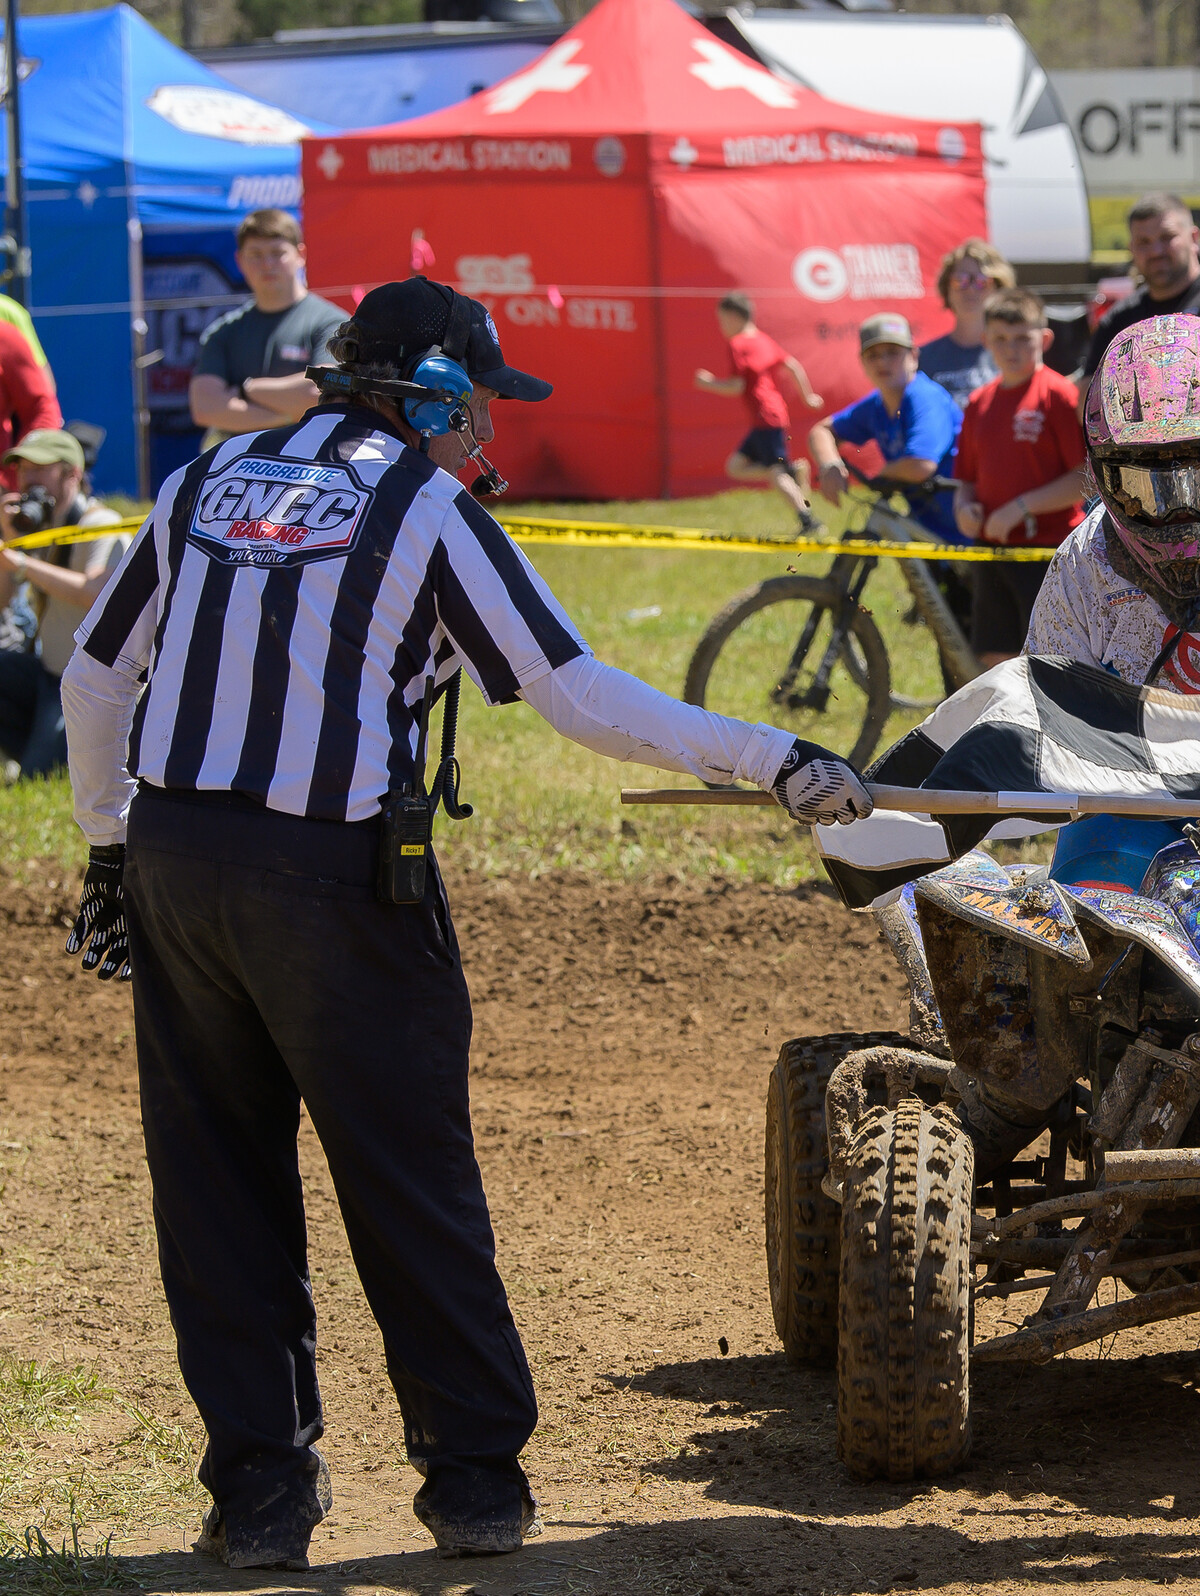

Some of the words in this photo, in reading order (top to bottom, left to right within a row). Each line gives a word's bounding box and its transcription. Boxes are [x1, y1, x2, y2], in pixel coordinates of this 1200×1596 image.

[367, 144, 469, 174] MEDICAL
[472, 140, 571, 171] STATION
[721, 133, 824, 167] MEDICAL
[234, 461, 338, 483] PROGRESSIVE
[200, 478, 360, 530] GNCC
[224, 520, 311, 546] RACING
